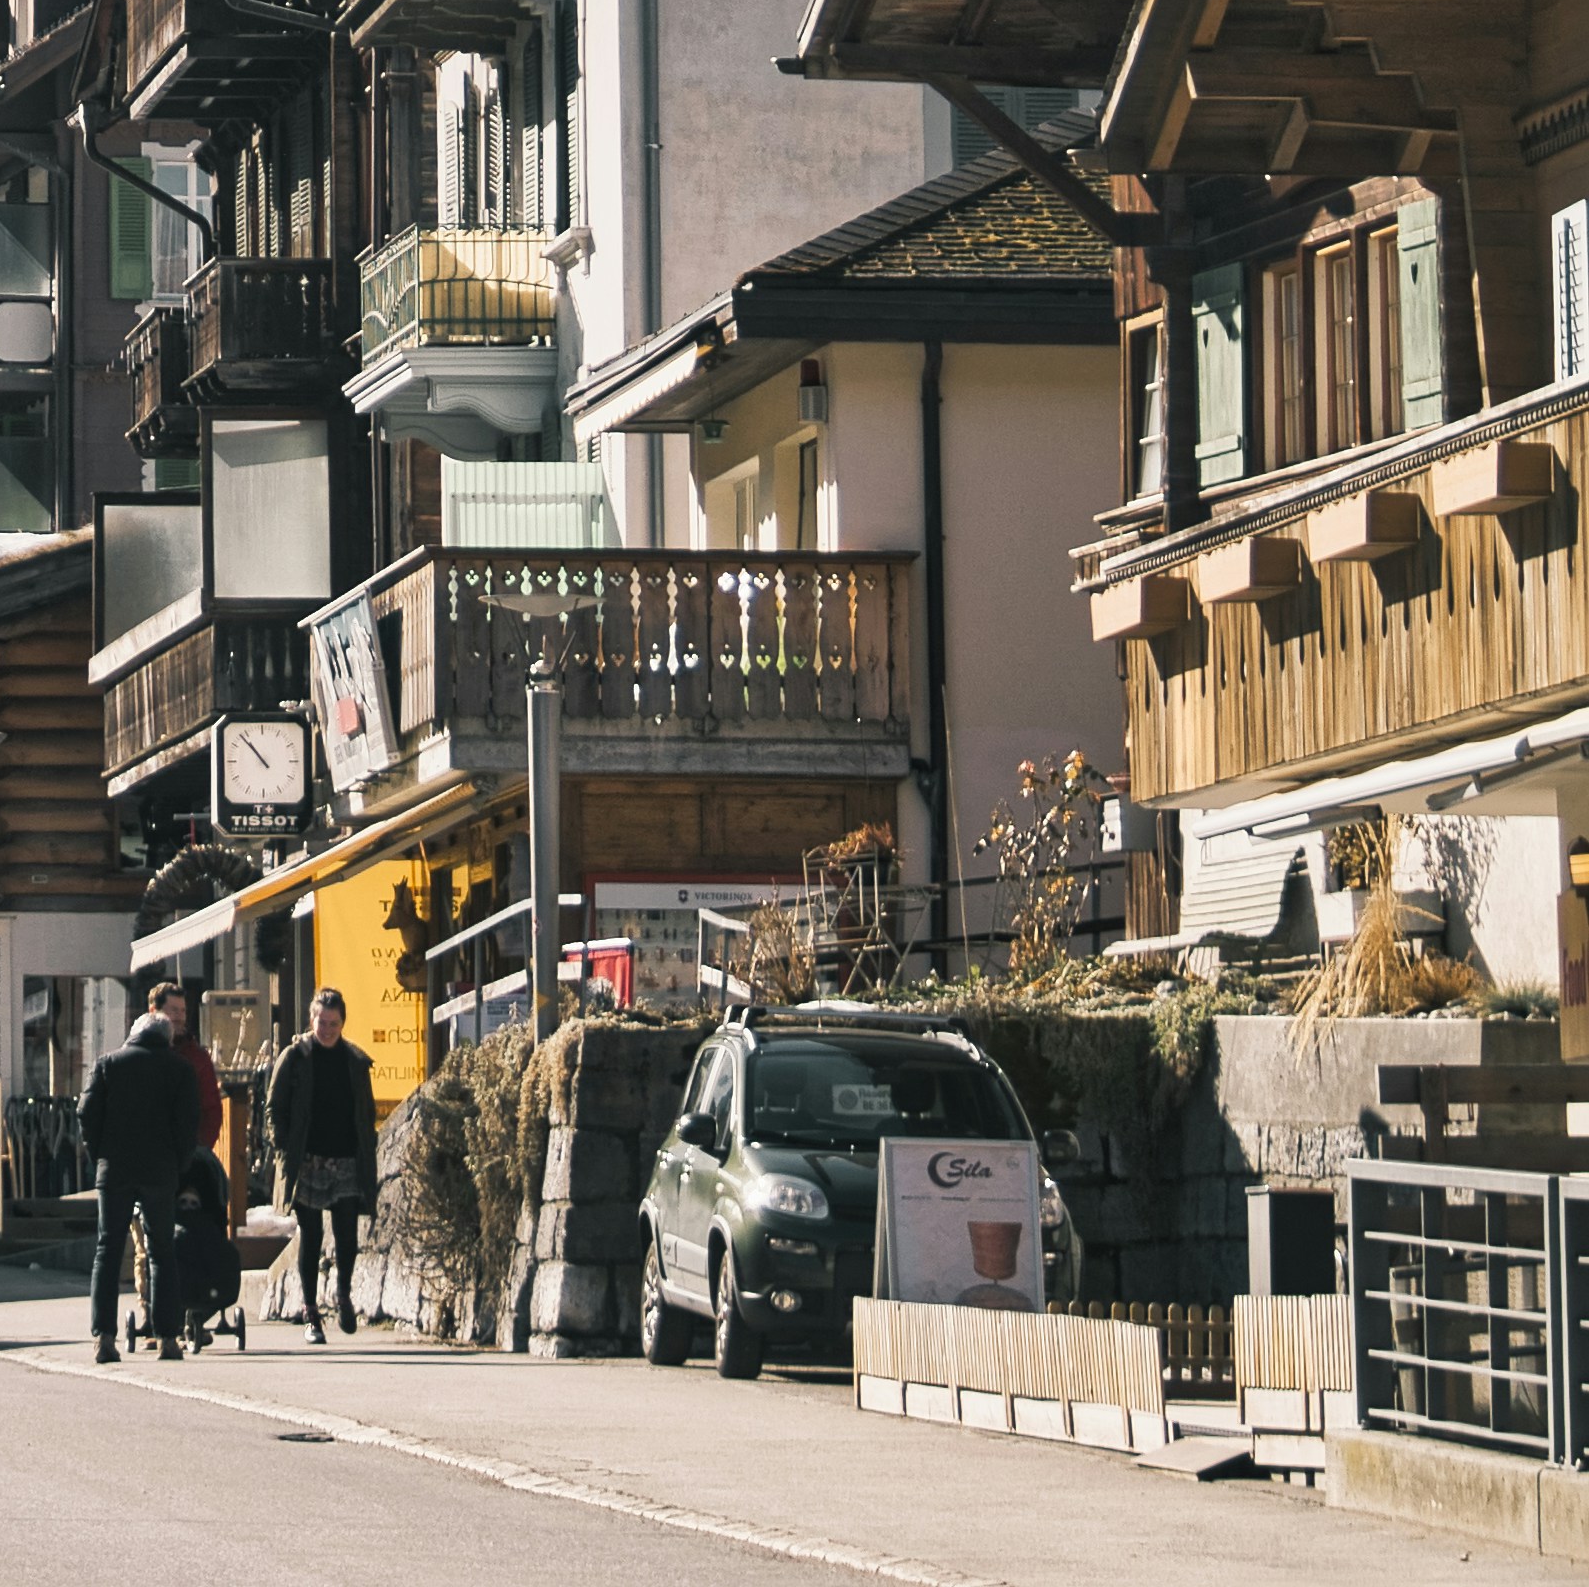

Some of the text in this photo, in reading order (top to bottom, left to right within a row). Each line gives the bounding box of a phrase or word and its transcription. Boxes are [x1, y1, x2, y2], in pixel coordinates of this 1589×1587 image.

[231, 815, 298, 826] TISSOT
[693, 890, 753, 902] VICTORINOX
[946, 1158, 993, 1178] Sila
